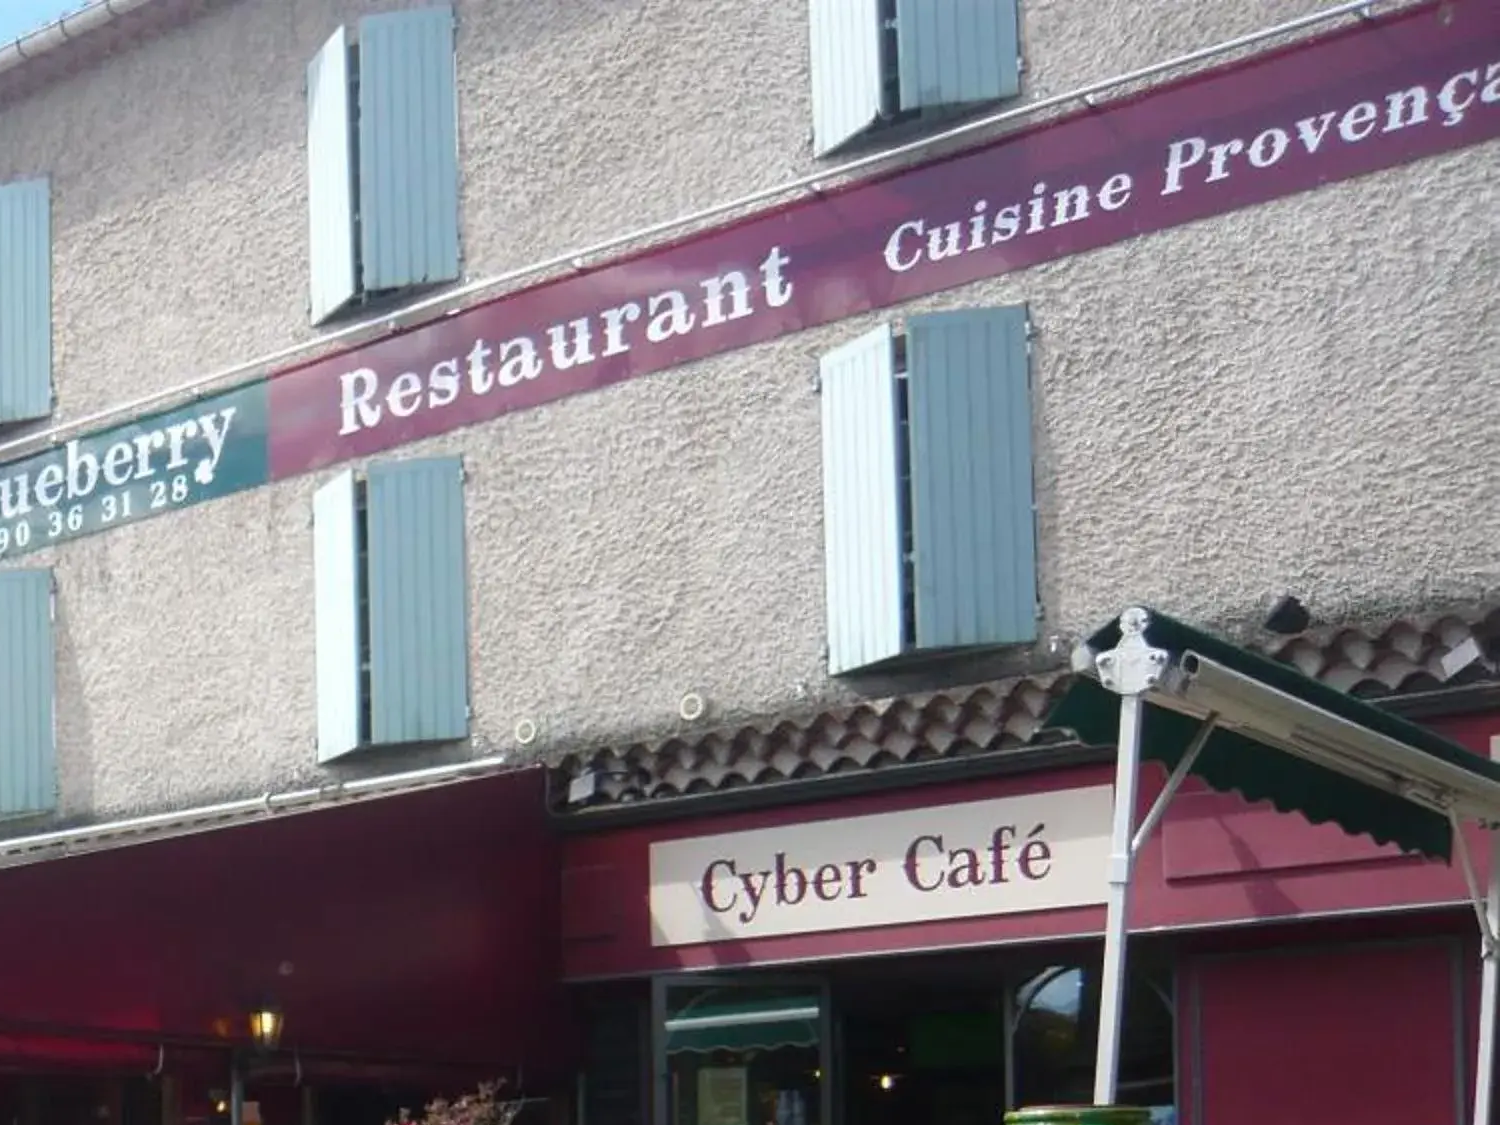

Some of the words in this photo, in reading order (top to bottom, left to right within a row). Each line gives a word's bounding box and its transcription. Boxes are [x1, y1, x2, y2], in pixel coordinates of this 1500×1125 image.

[883, 172, 1132, 273] Cuisine
[338, 246, 794, 436] Restaurant
[48, 504, 83, 537] 36
[102, 490, 132, 522] 31
[150, 474, 189, 508] 28
[701, 852, 877, 923] Cyber
[904, 823, 1052, 891] Café
